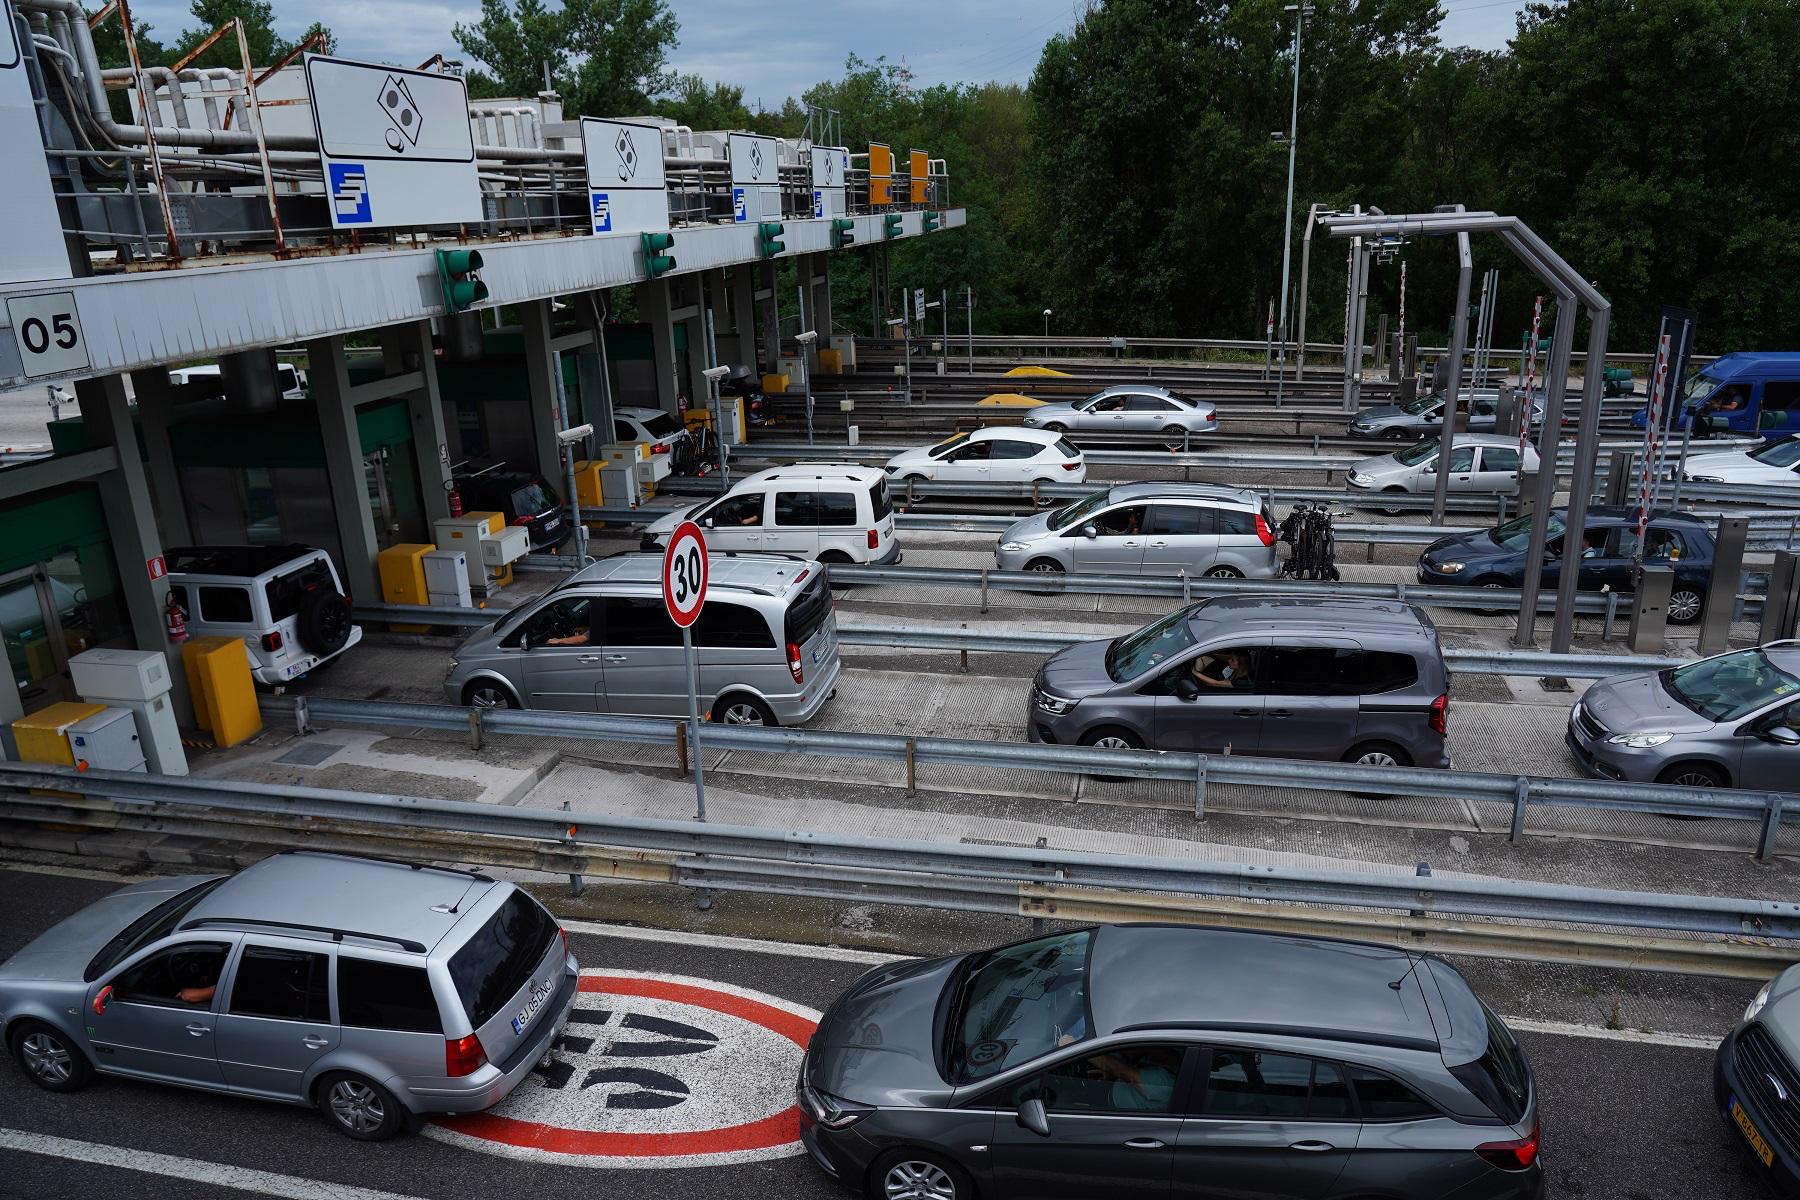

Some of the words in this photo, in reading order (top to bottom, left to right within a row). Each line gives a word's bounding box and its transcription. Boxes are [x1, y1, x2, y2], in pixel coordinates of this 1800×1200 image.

[21, 313, 77, 354] 05
[674, 546, 701, 603] 30
[519, 1007, 530, 1025] GJ
[528, 996, 538, 1012] 05
[536, 979, 552, 1003] DNC
